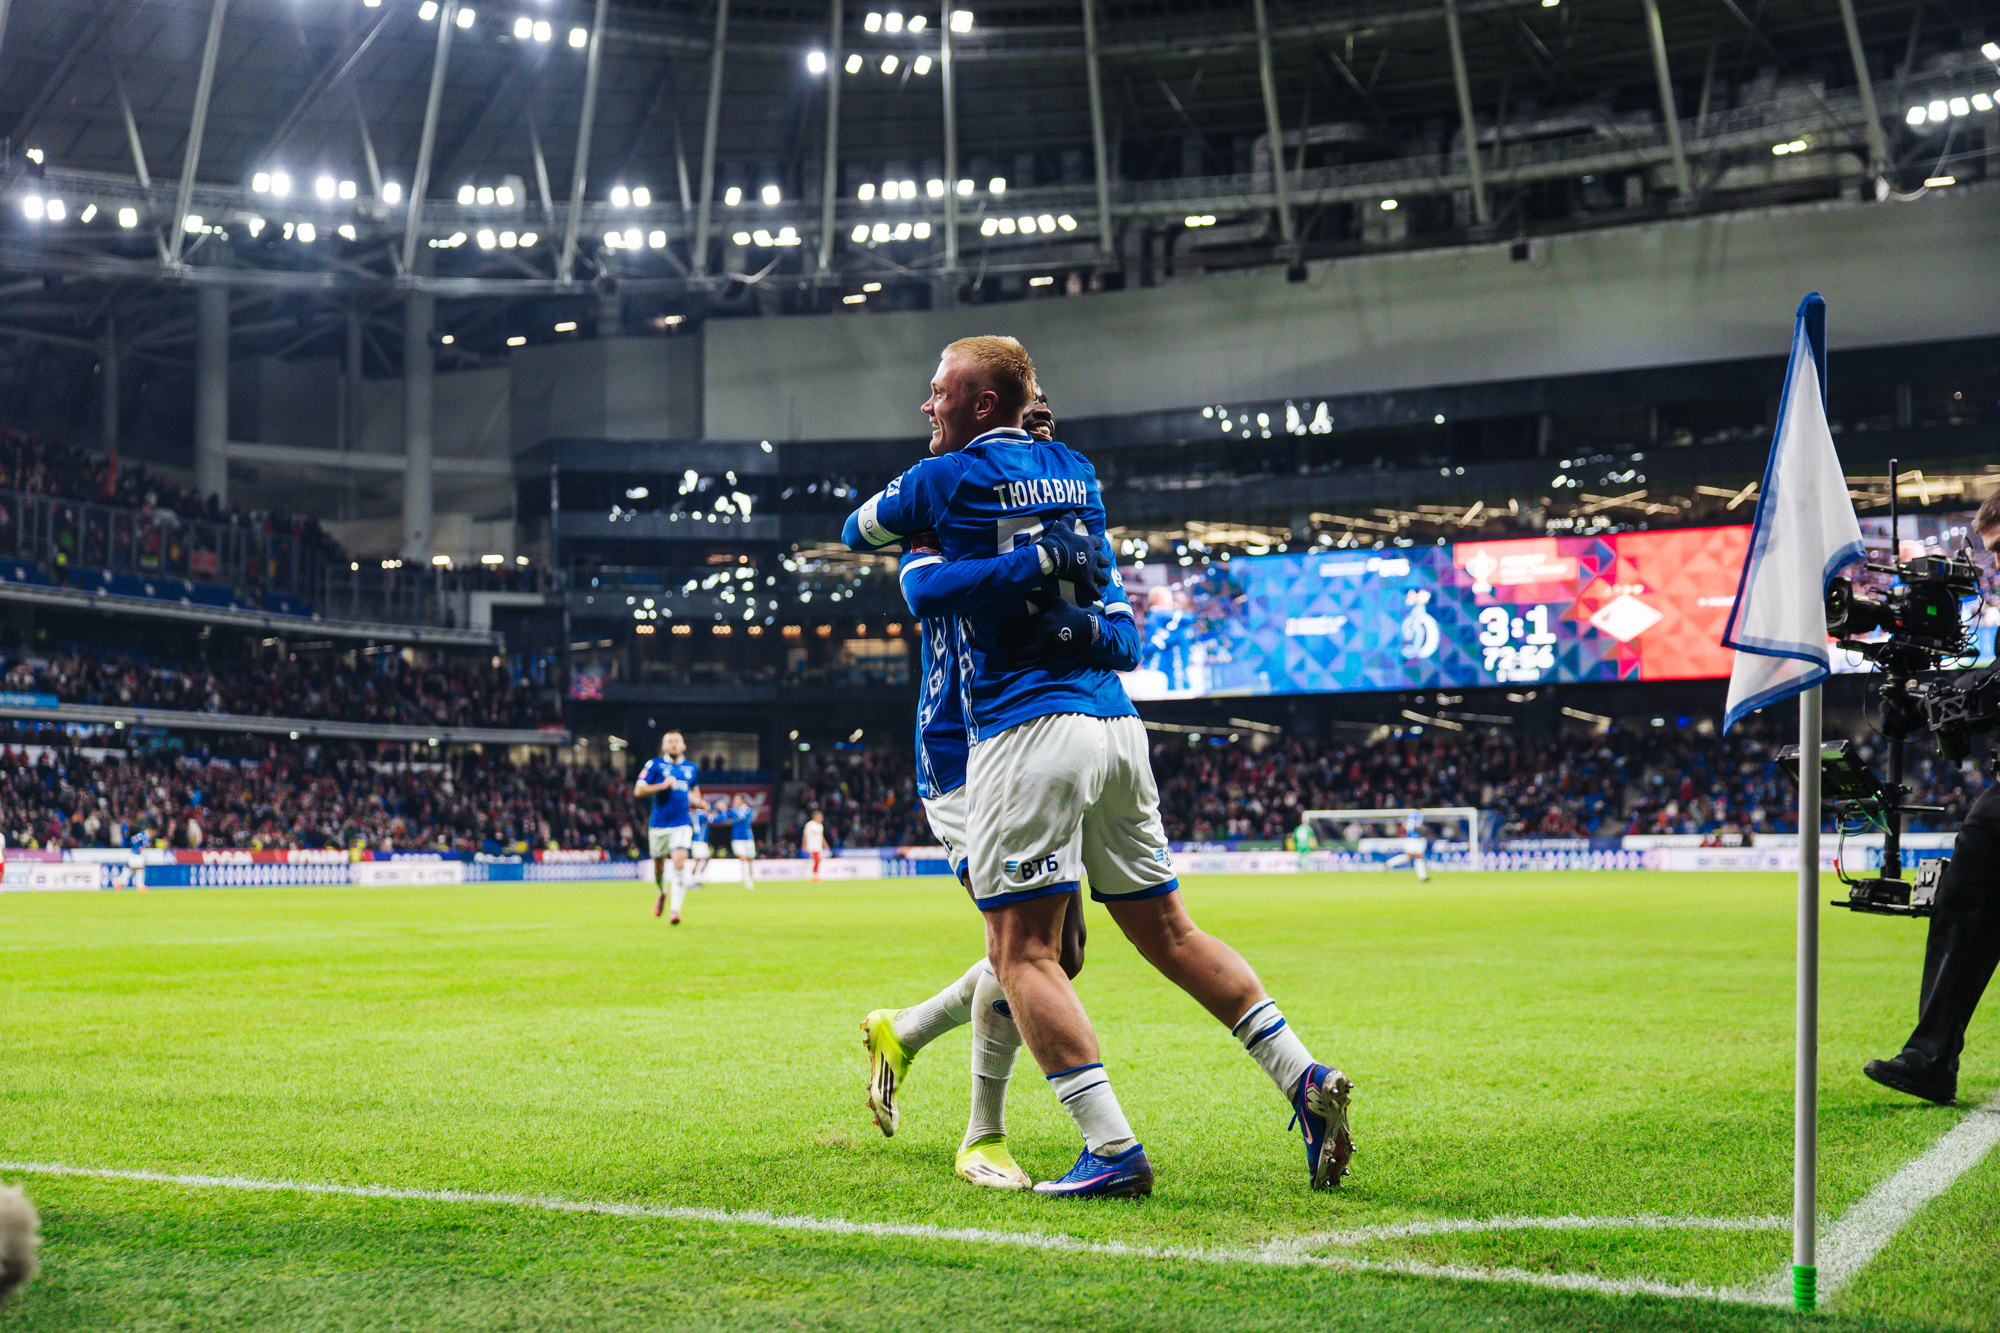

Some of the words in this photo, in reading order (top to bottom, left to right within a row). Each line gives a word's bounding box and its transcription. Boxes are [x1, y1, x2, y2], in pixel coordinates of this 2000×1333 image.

[993, 478, 1087, 510] ТЮКАВИН
[1479, 604, 1556, 647] 3:1
[1021, 854, 1059, 880] ВТБ
